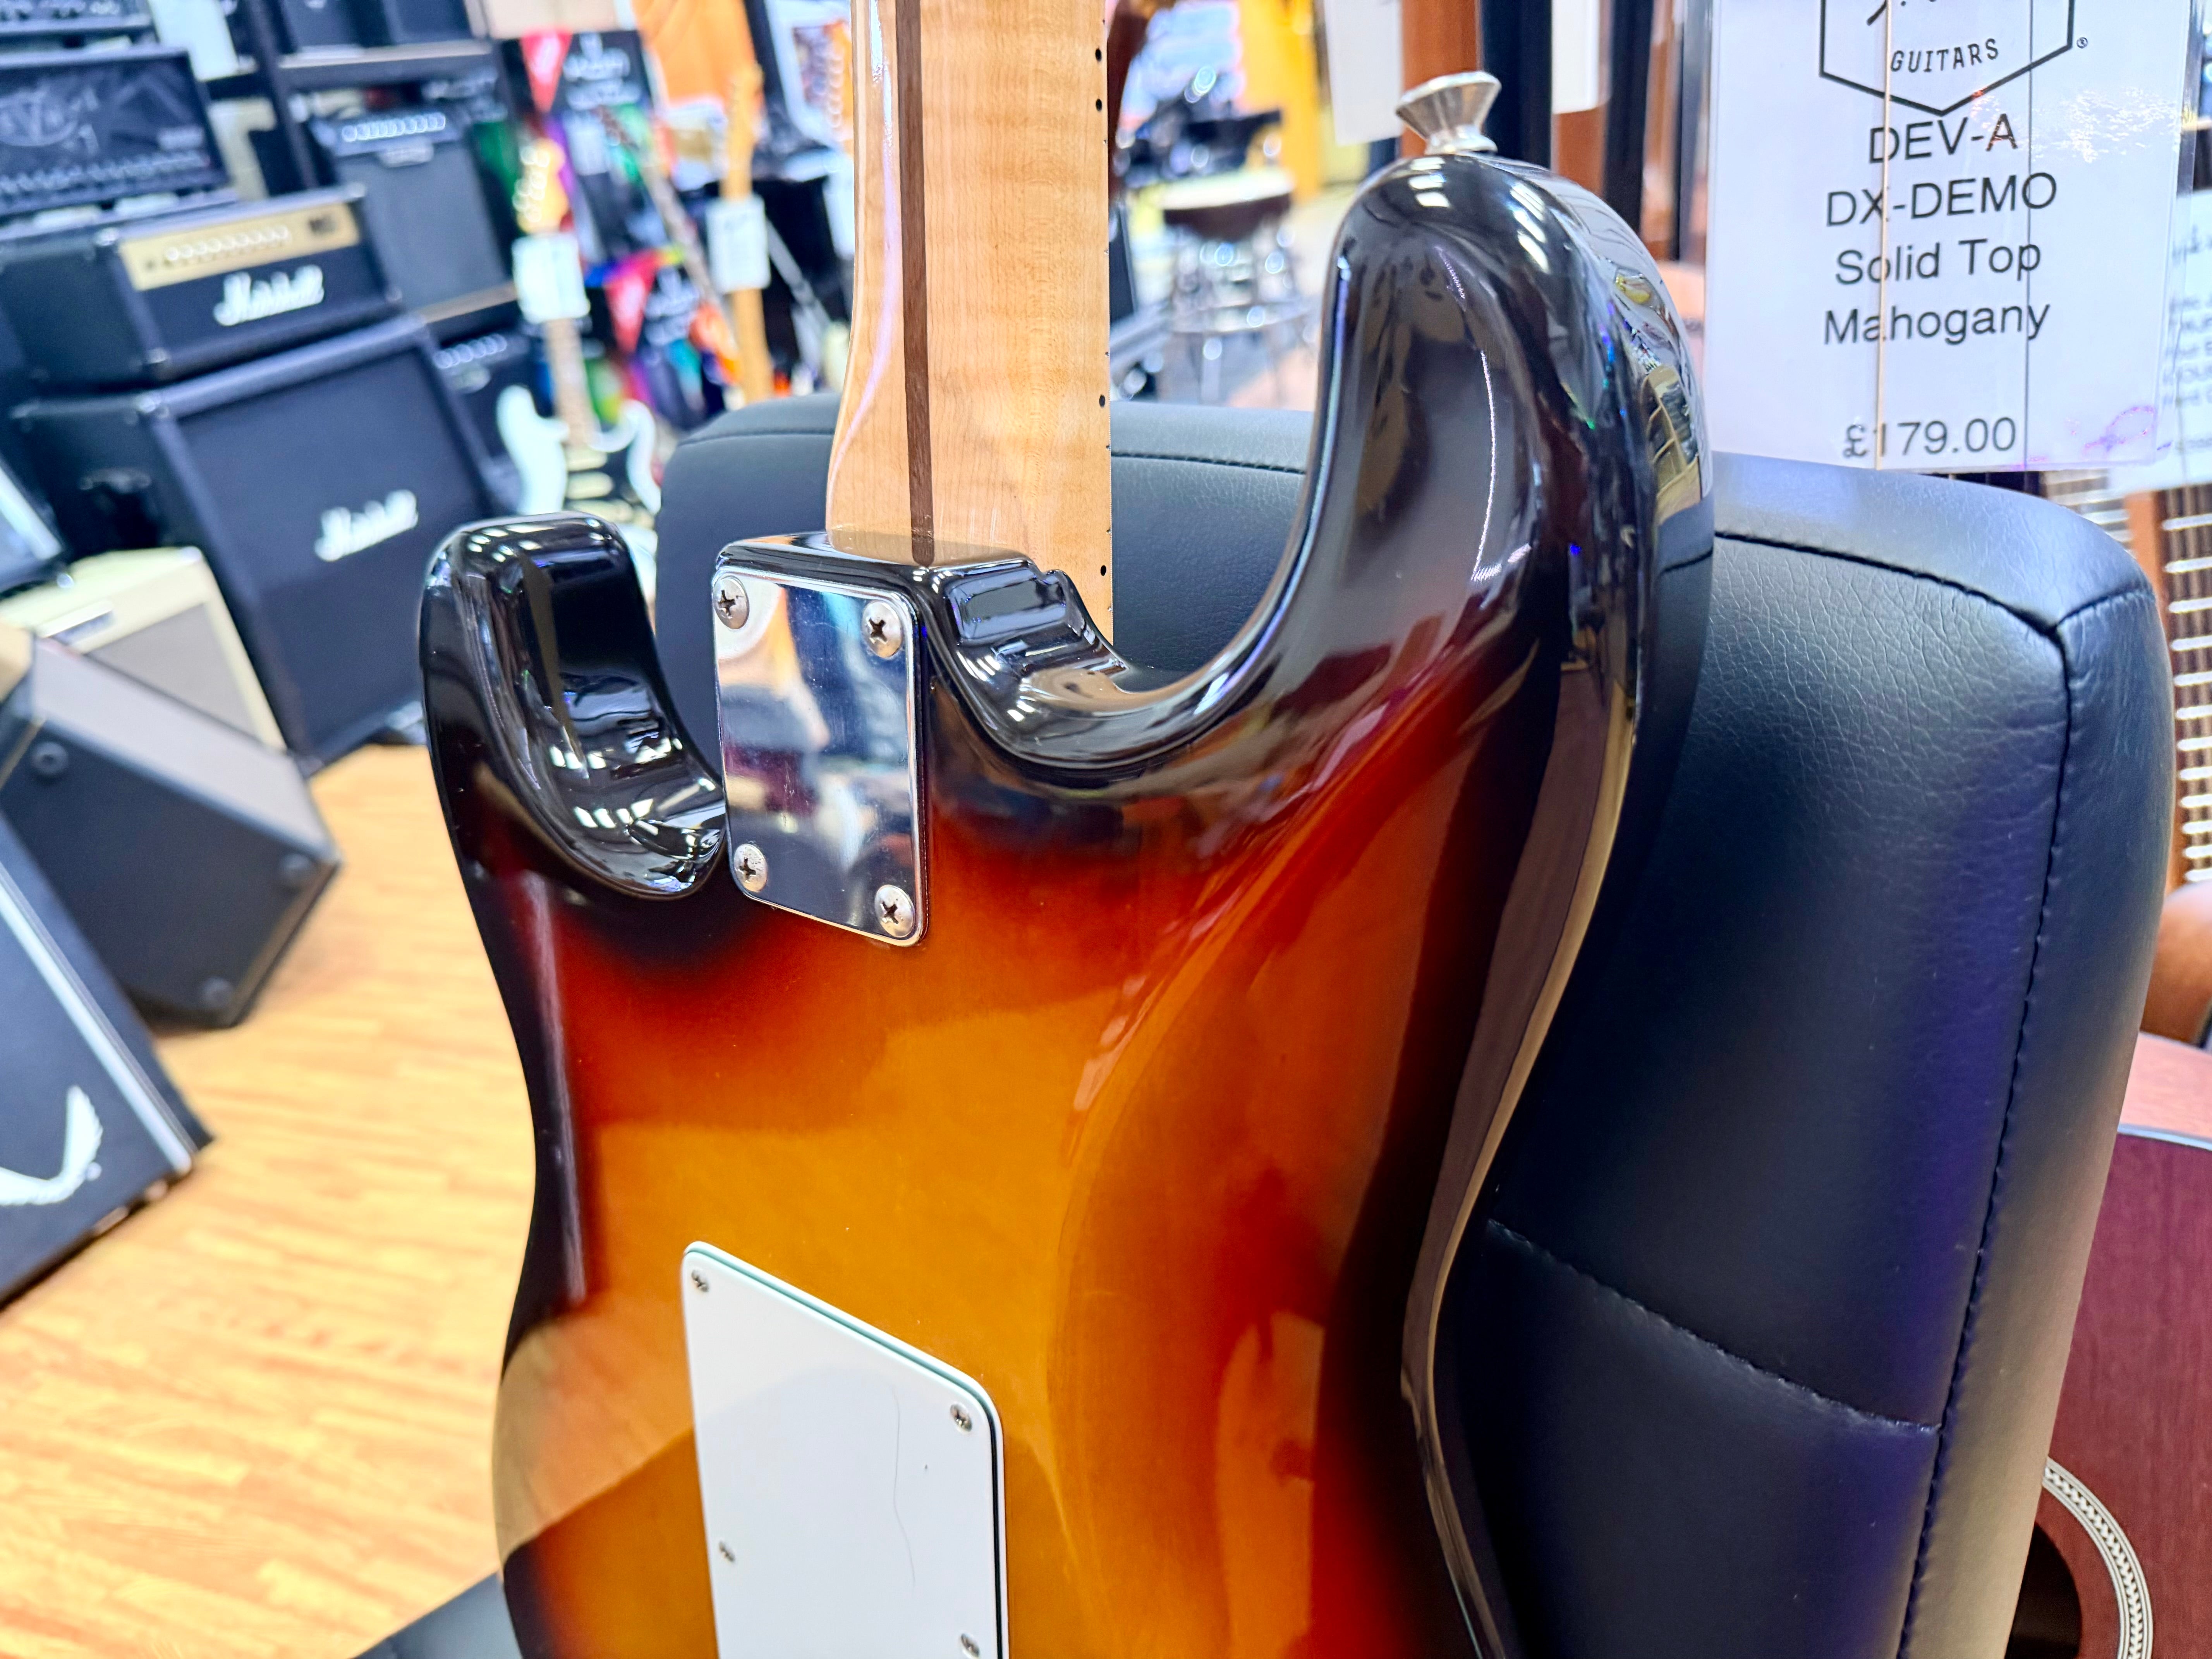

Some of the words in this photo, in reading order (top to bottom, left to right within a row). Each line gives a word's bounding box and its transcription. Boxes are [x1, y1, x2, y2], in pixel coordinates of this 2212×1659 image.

[1891, 38, 1999, 73] GUITARS
[1869, 113, 2019, 164] DEV-A
[1826, 172, 2057, 227] DX-DEMO
[1835, 242, 1941, 285] Solid
[1958, 238, 2041, 281] Top
[1824, 303, 2051, 345] Mahogany
[1843, 417, 2016, 458] £179.00
